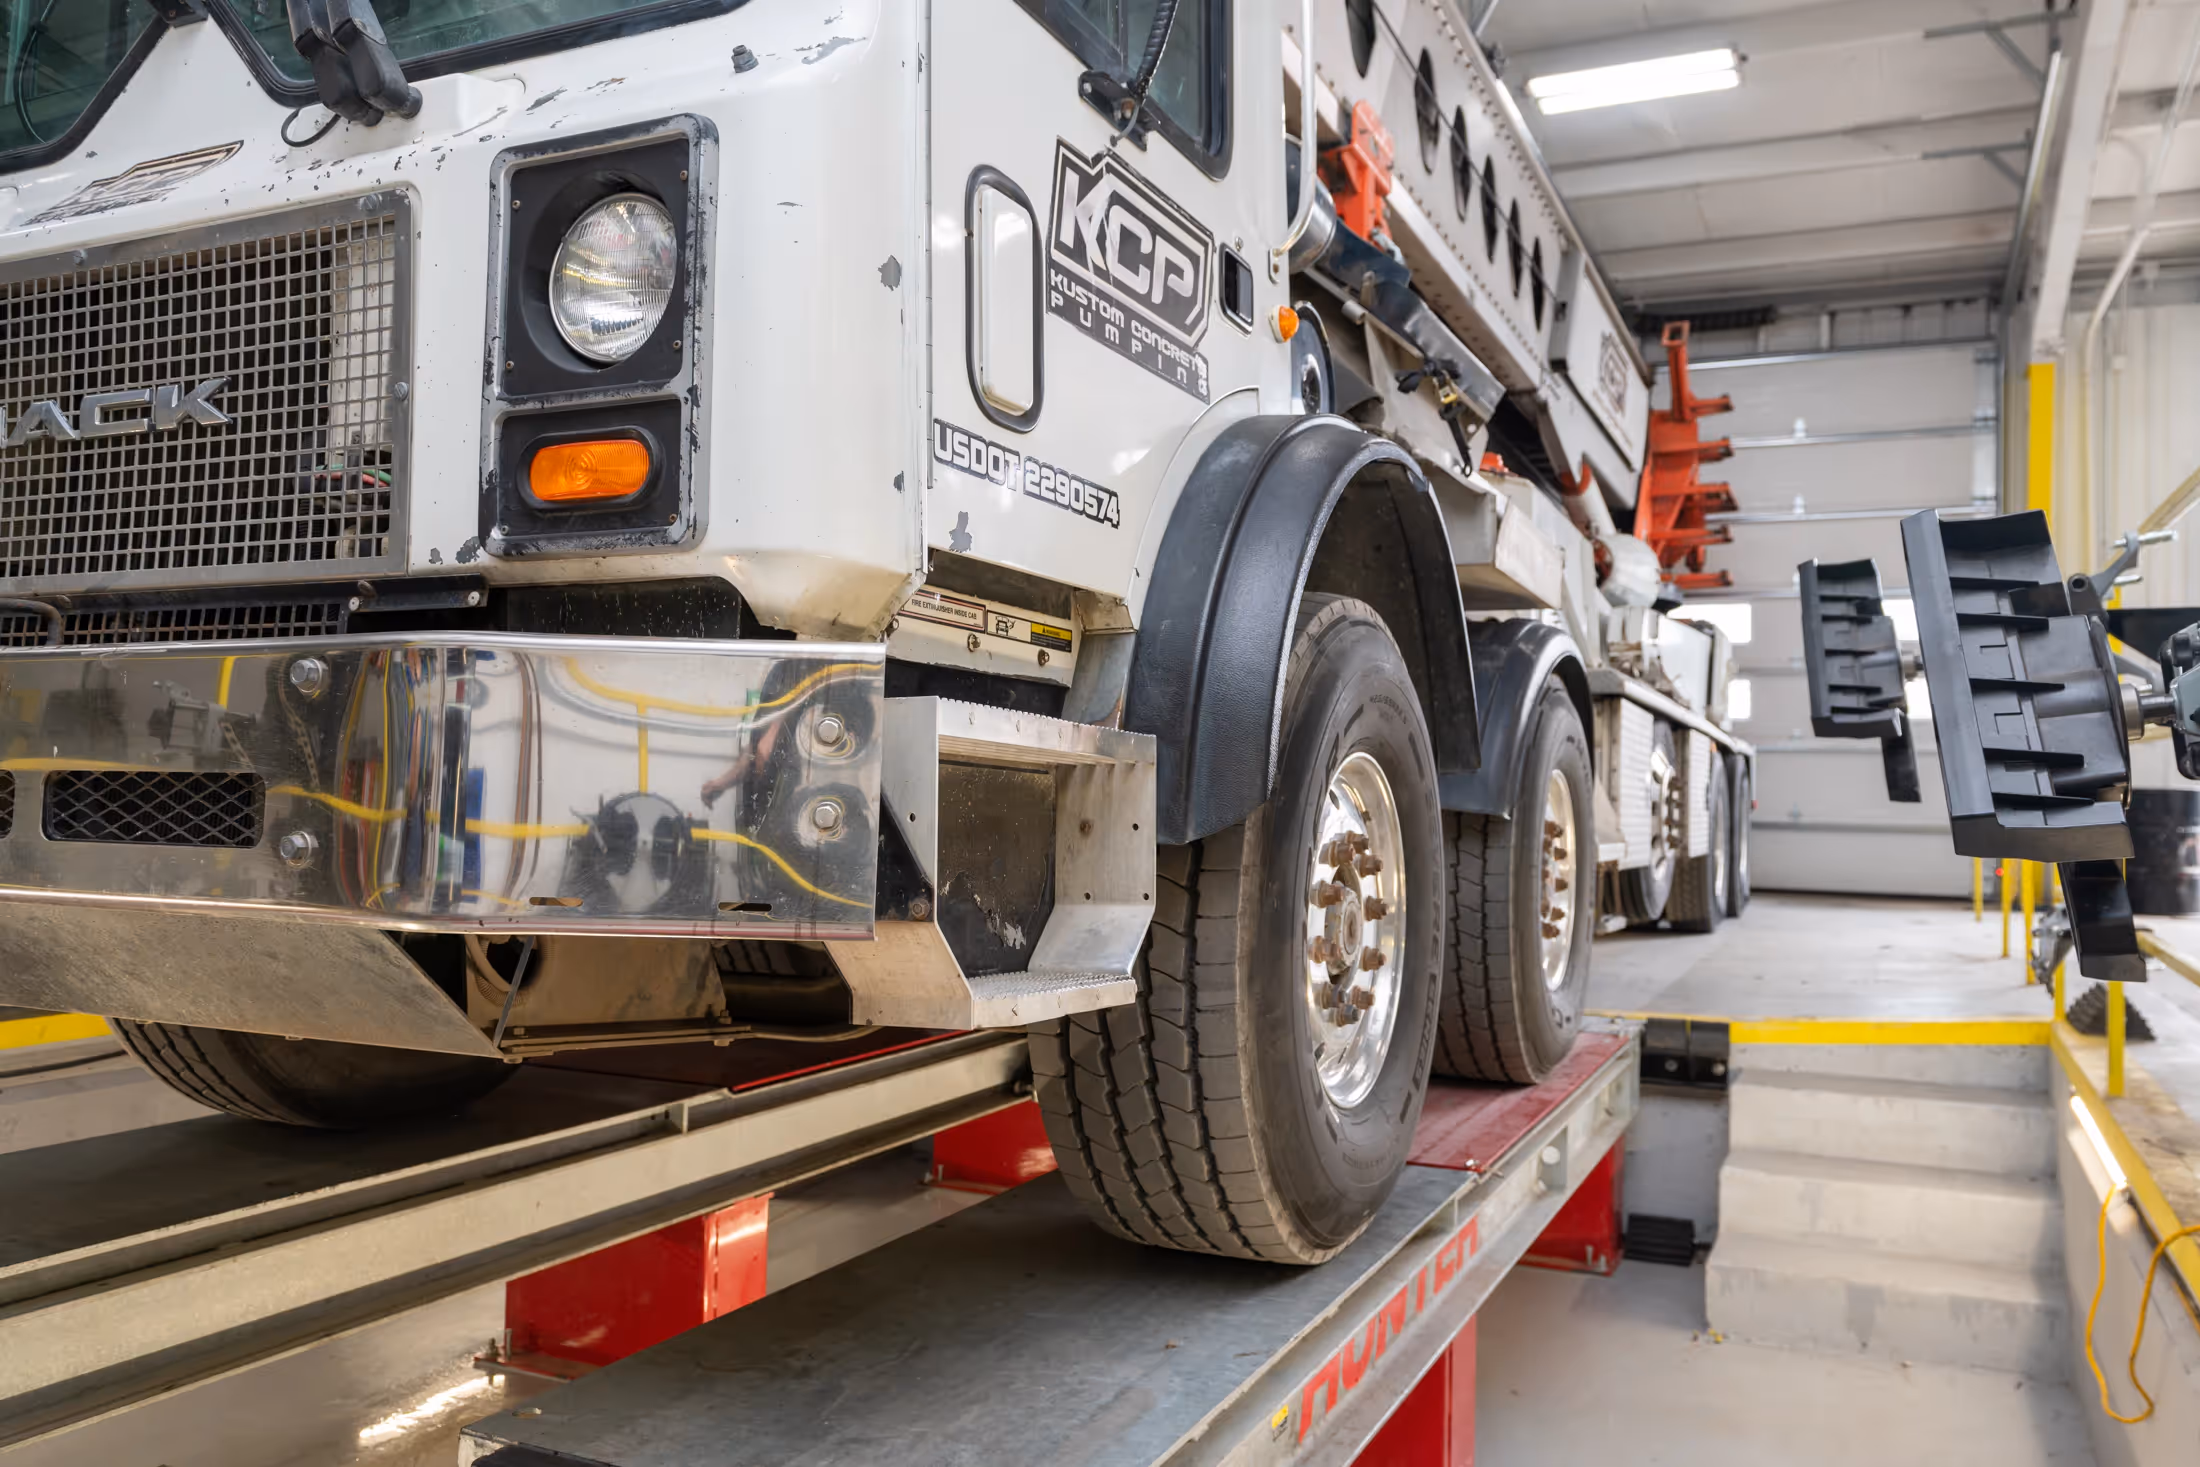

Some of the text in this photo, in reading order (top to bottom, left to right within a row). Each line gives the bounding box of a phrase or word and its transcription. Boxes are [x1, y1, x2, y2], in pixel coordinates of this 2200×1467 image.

[1059, 166, 1198, 305] KCP
[1050, 268, 1125, 329] KUSTOM
[0, 376, 233, 450] ACK
[934, 420, 1120, 528] USDOT 2290574
[911, 598, 922, 608] FIRE
[953, 608, 968, 618] INSIDE
[967, 611, 977, 620] CAB
